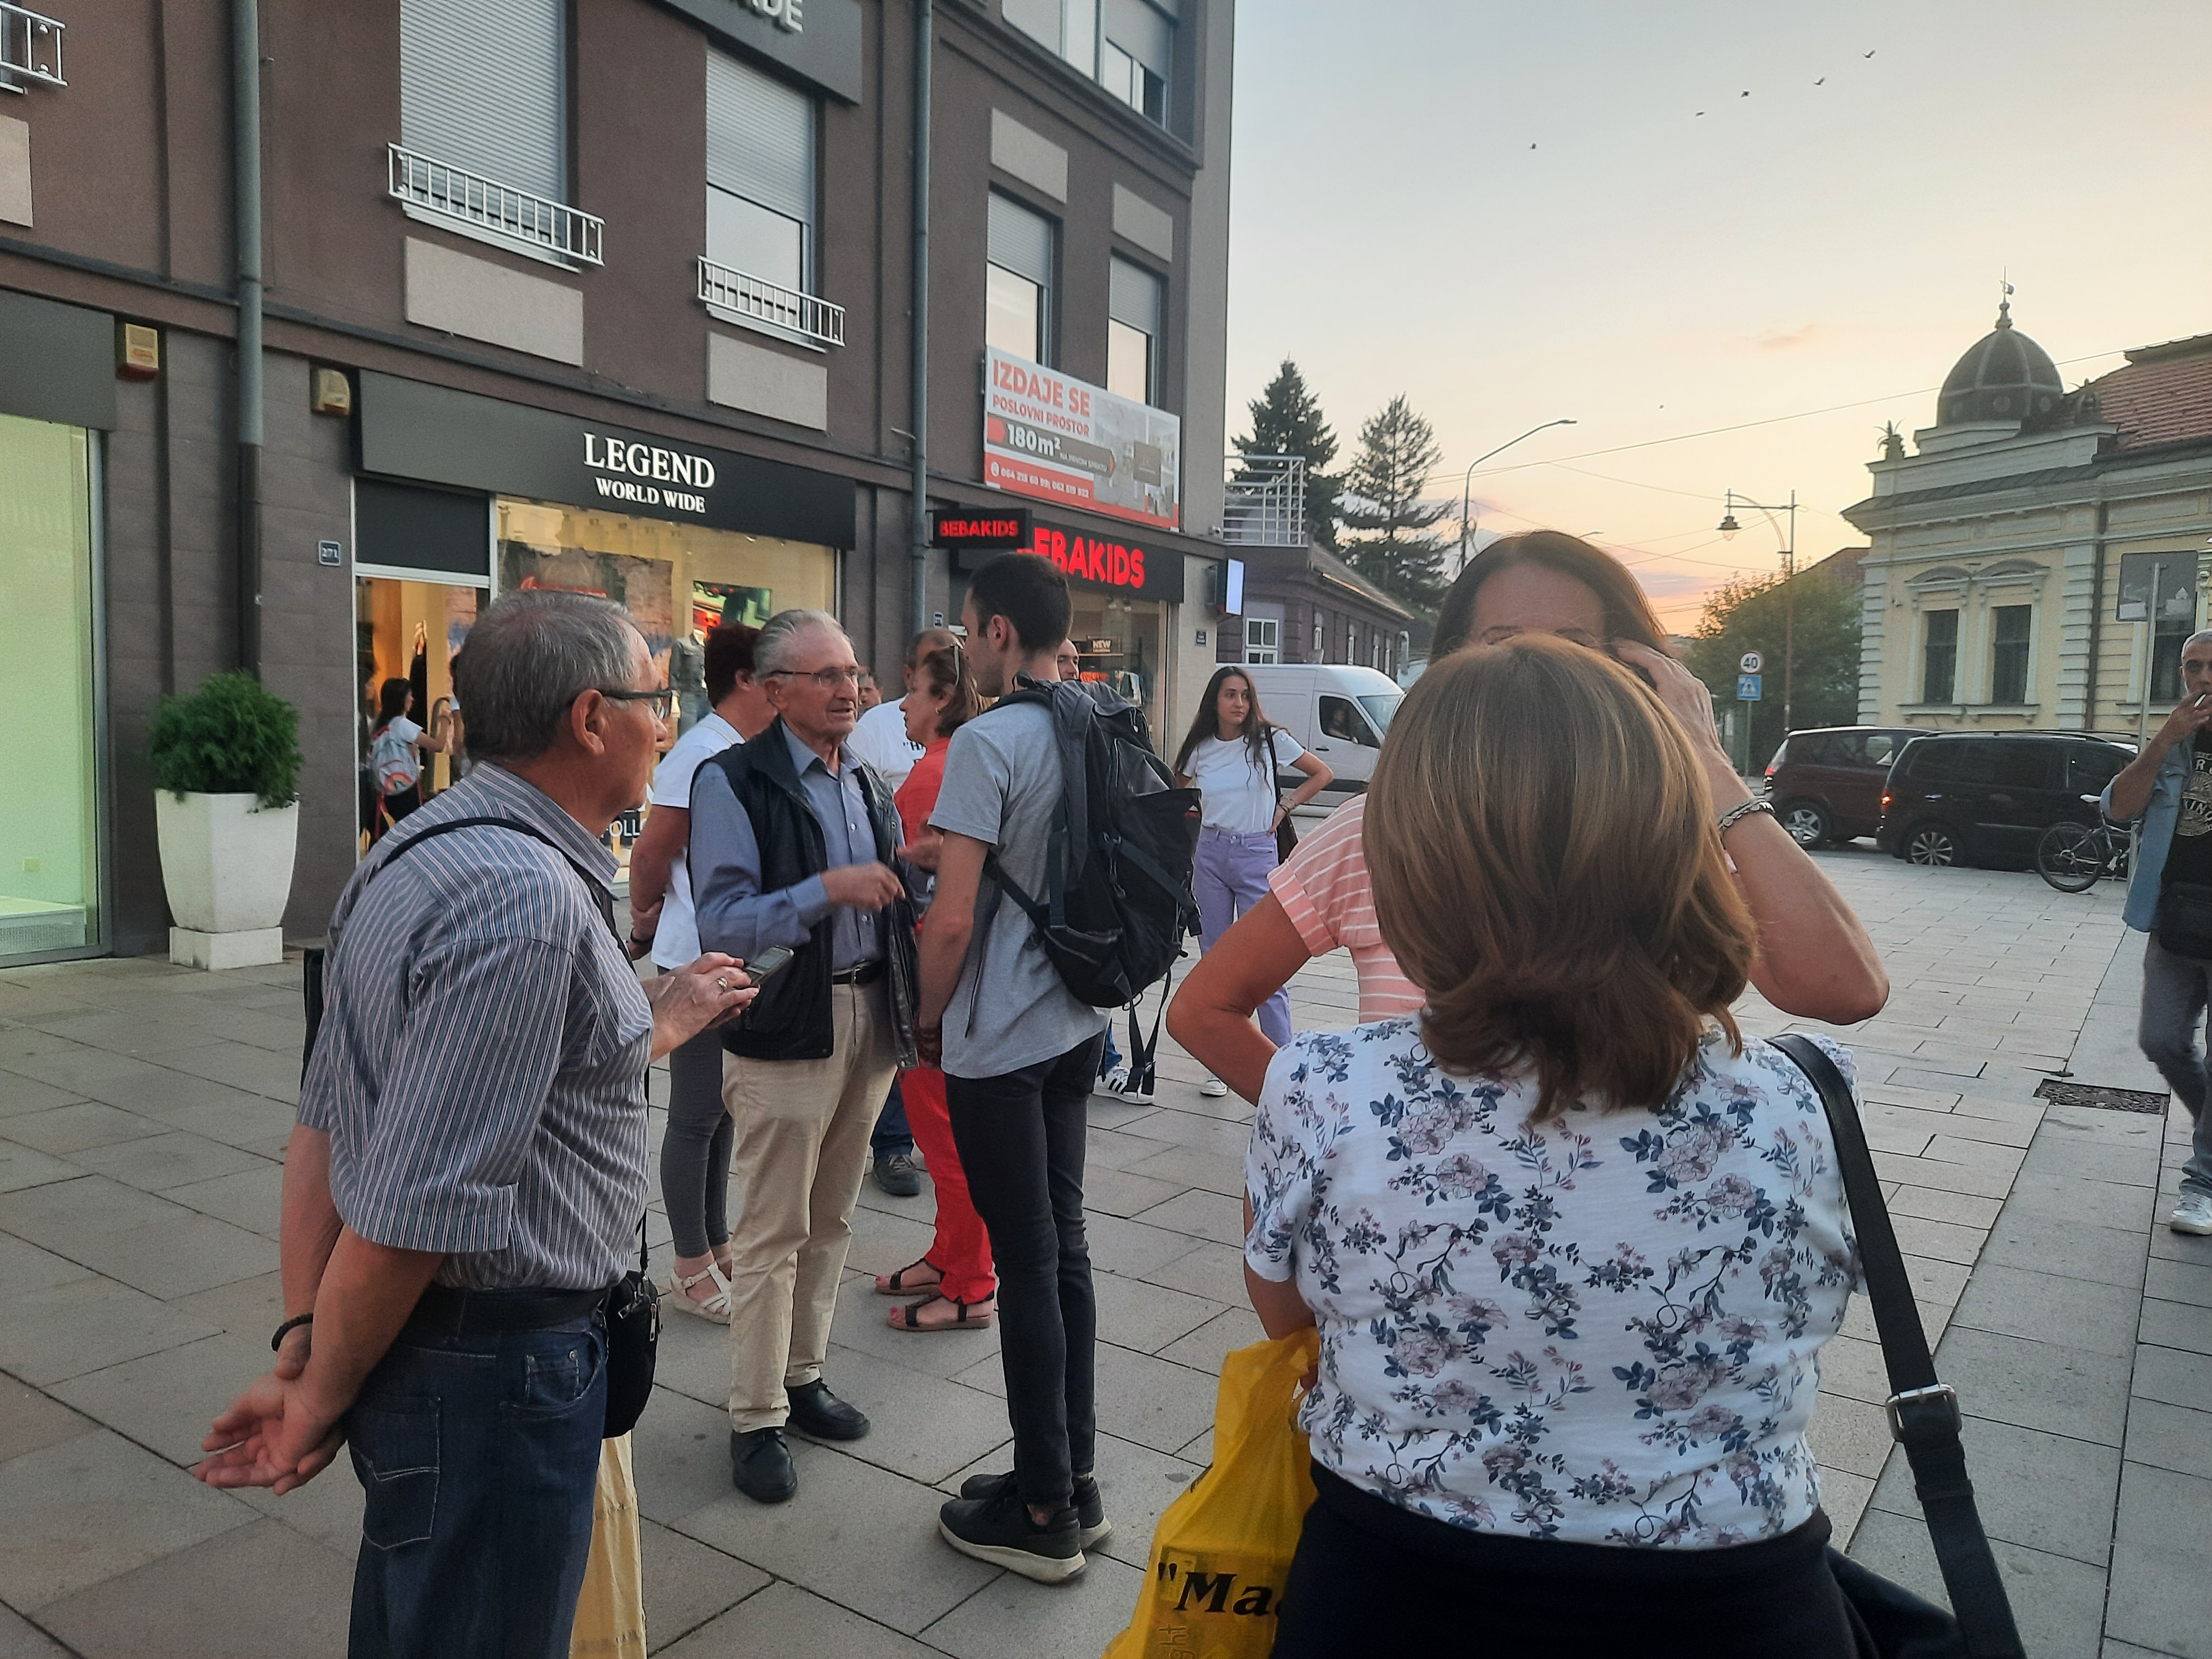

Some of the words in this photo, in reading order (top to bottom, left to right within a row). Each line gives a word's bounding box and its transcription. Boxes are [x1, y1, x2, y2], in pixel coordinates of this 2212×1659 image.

[993, 359, 1063, 409] IZDAJE
[1069, 387, 1090, 418] SE
[993, 394, 1044, 423] POSLOVNI
[1046, 411, 1090, 436] PROSTOR
[583, 432, 716, 488] LEGEND
[594, 476, 660, 504] WORLD
[662, 489, 706, 514] WIDE
[940, 519, 1019, 537] BEBAKIDS
[1017, 527, 1145, 589] EBAKIDS
[1743, 657, 1758, 669] 40
[601, 818, 648, 838] OLL
[1157, 1562, 1281, 1616] "Ma
